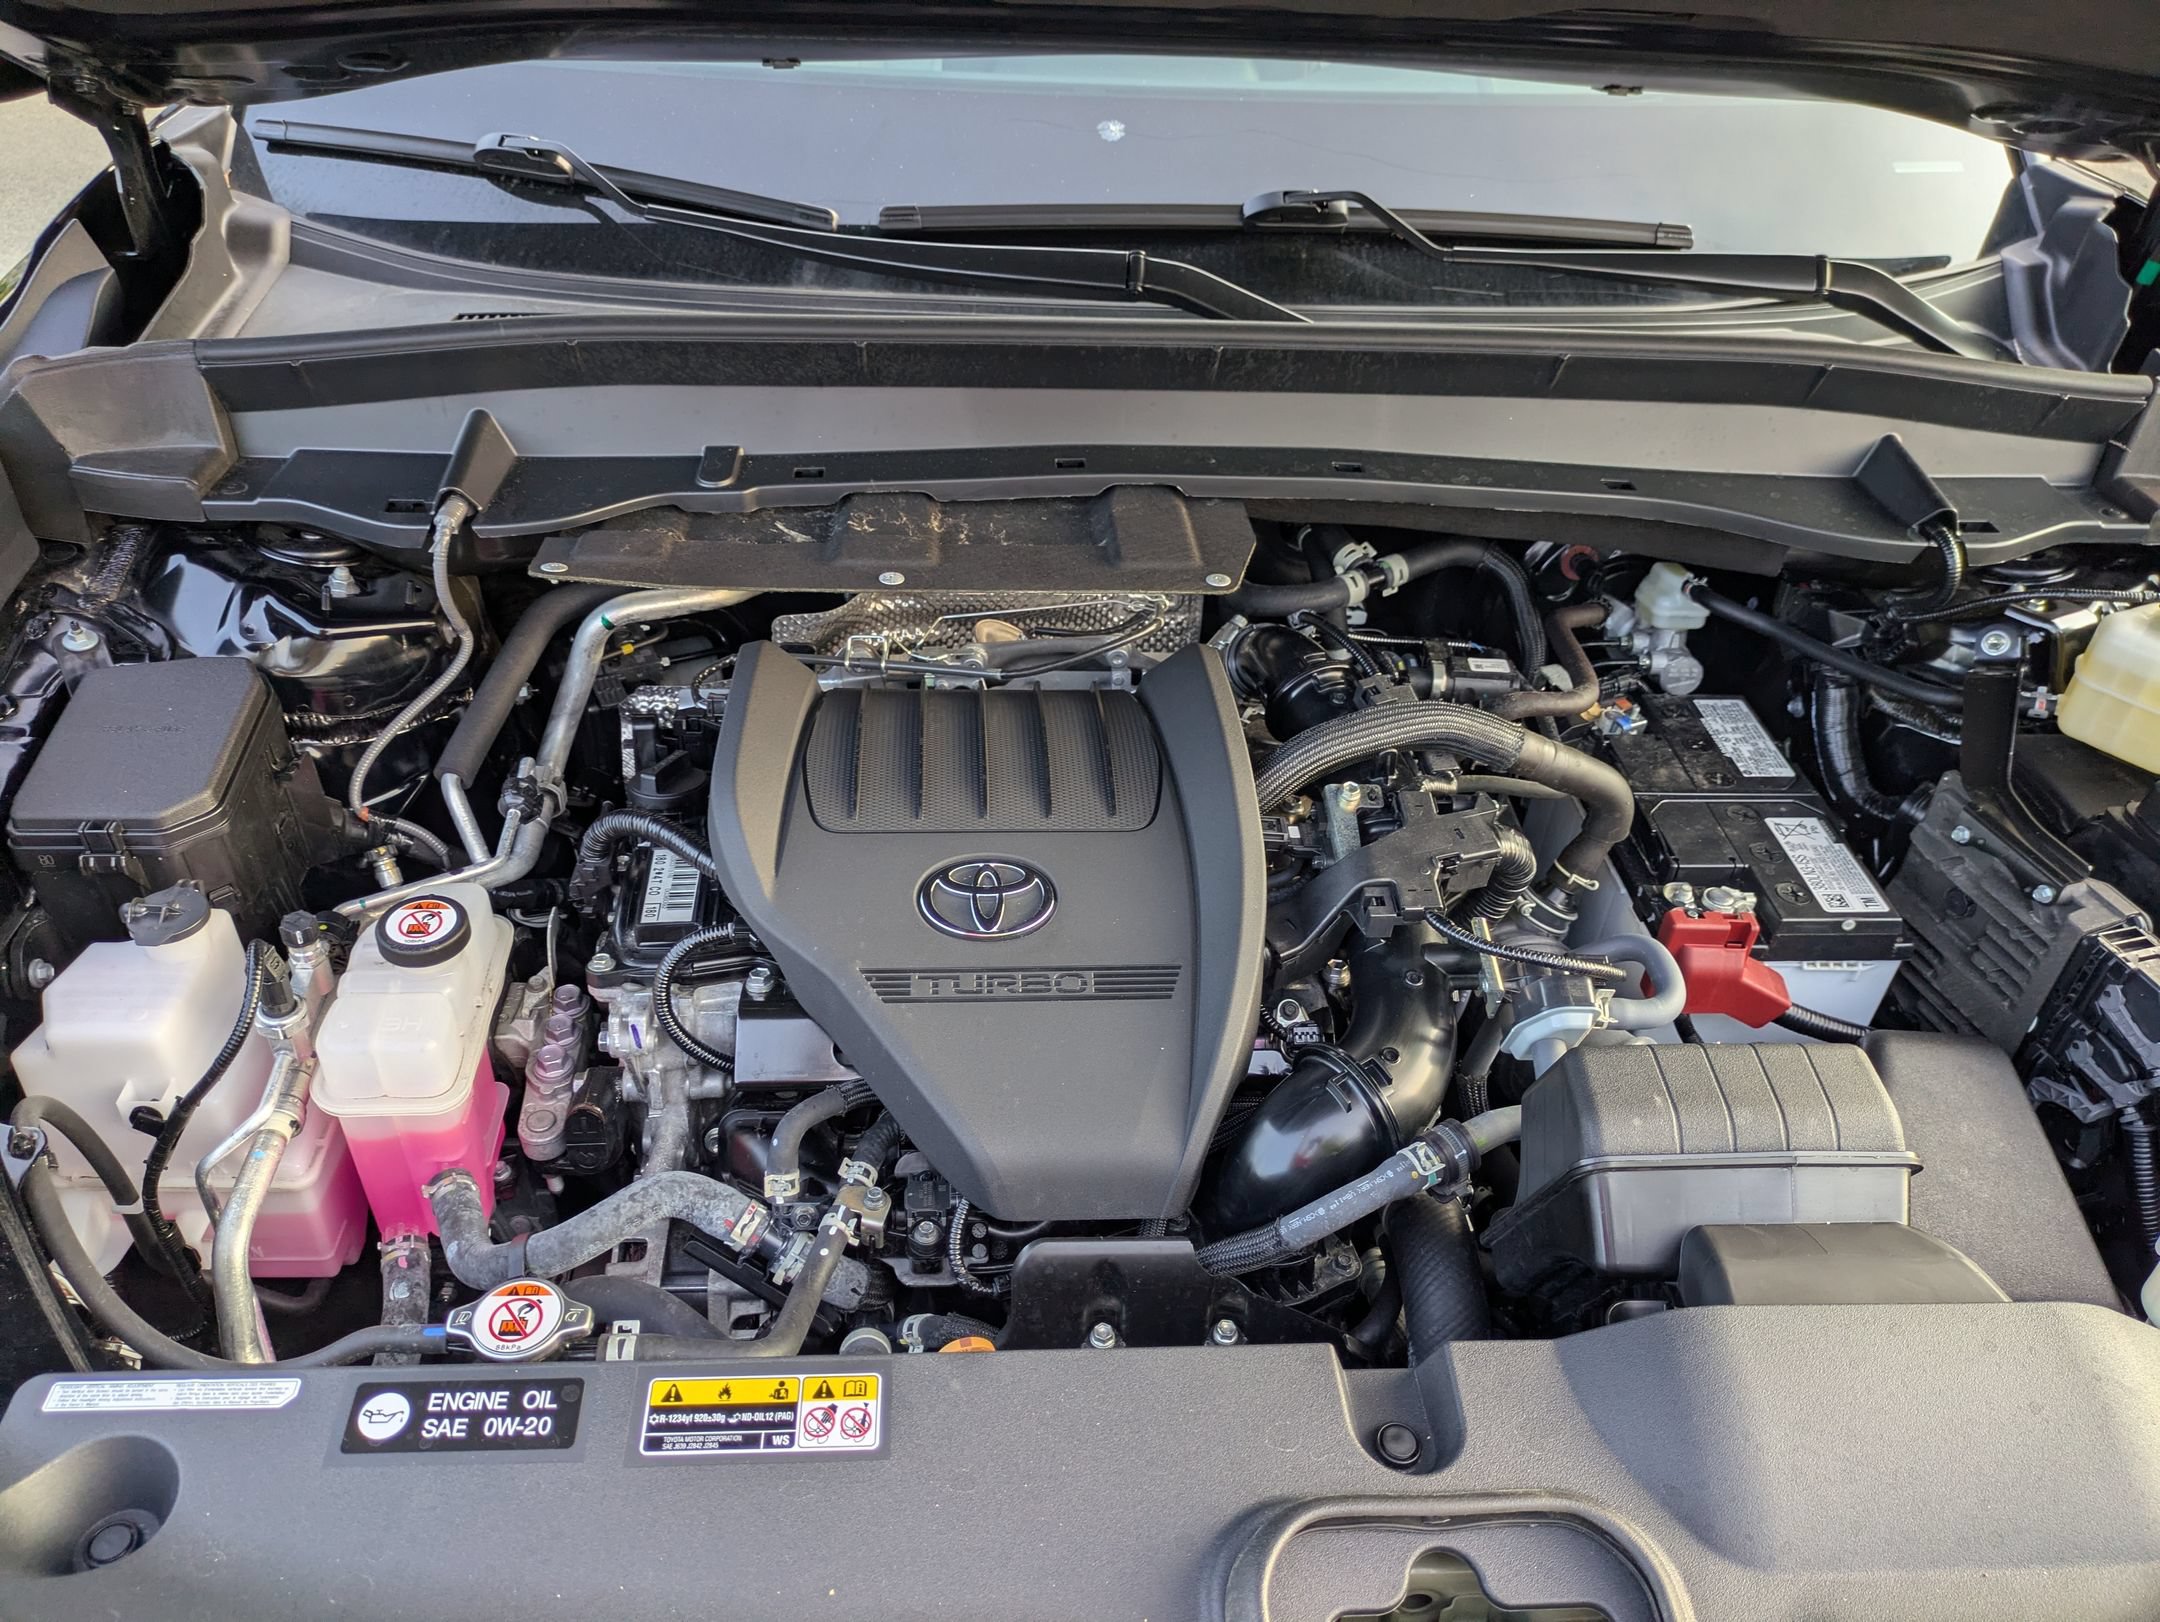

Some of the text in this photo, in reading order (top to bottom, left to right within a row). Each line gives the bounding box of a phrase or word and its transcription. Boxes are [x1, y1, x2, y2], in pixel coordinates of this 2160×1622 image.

[915, 972, 1088, 996] TURBO
[427, 1390, 558, 1411] ENGINE OIL
[660, 1413, 693, 1424] R-1234yf
[775, 1411, 794, 1422] (PAG)
[421, 1416, 552, 1438] SAE 0W-20
[685, 1435, 704, 1443] MOTOR
[705, 1434, 743, 1442] CORPORATION
[772, 1435, 790, 1446] WS
